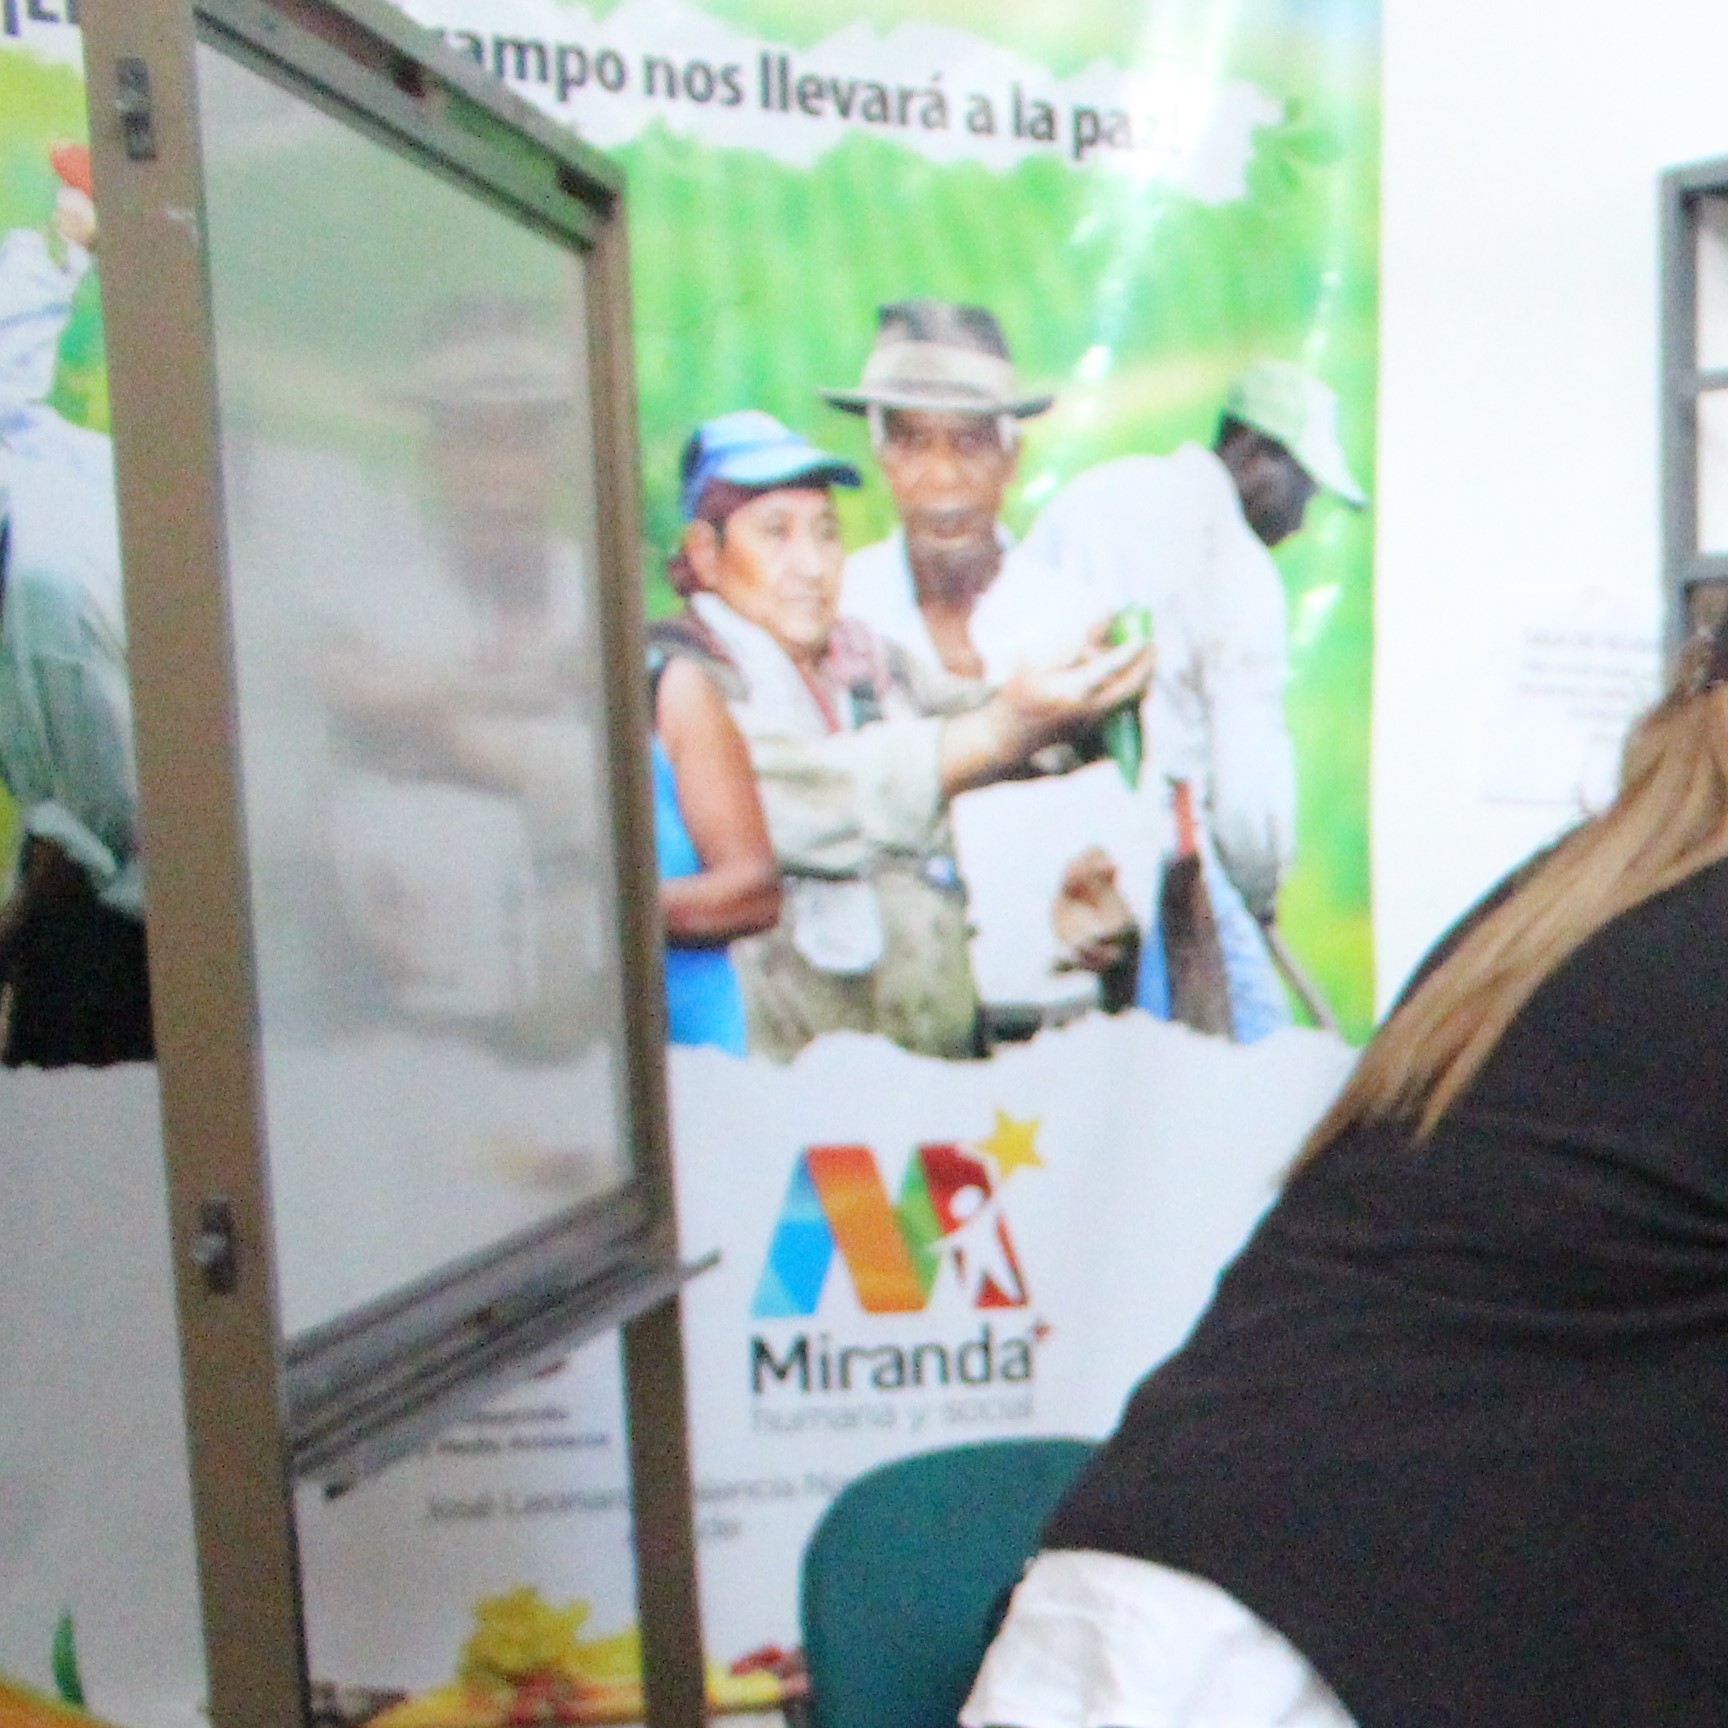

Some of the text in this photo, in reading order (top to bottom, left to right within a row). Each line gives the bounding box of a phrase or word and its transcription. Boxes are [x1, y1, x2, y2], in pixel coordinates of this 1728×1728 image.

[452, 28, 628, 103] ampo
[642, 53, 745, 111] nos
[758, 51, 949, 131] llevará
[965, 92, 997, 136] a
[1011, 82, 1057, 142] la
[752, 1323, 1032, 1393] Miranda
